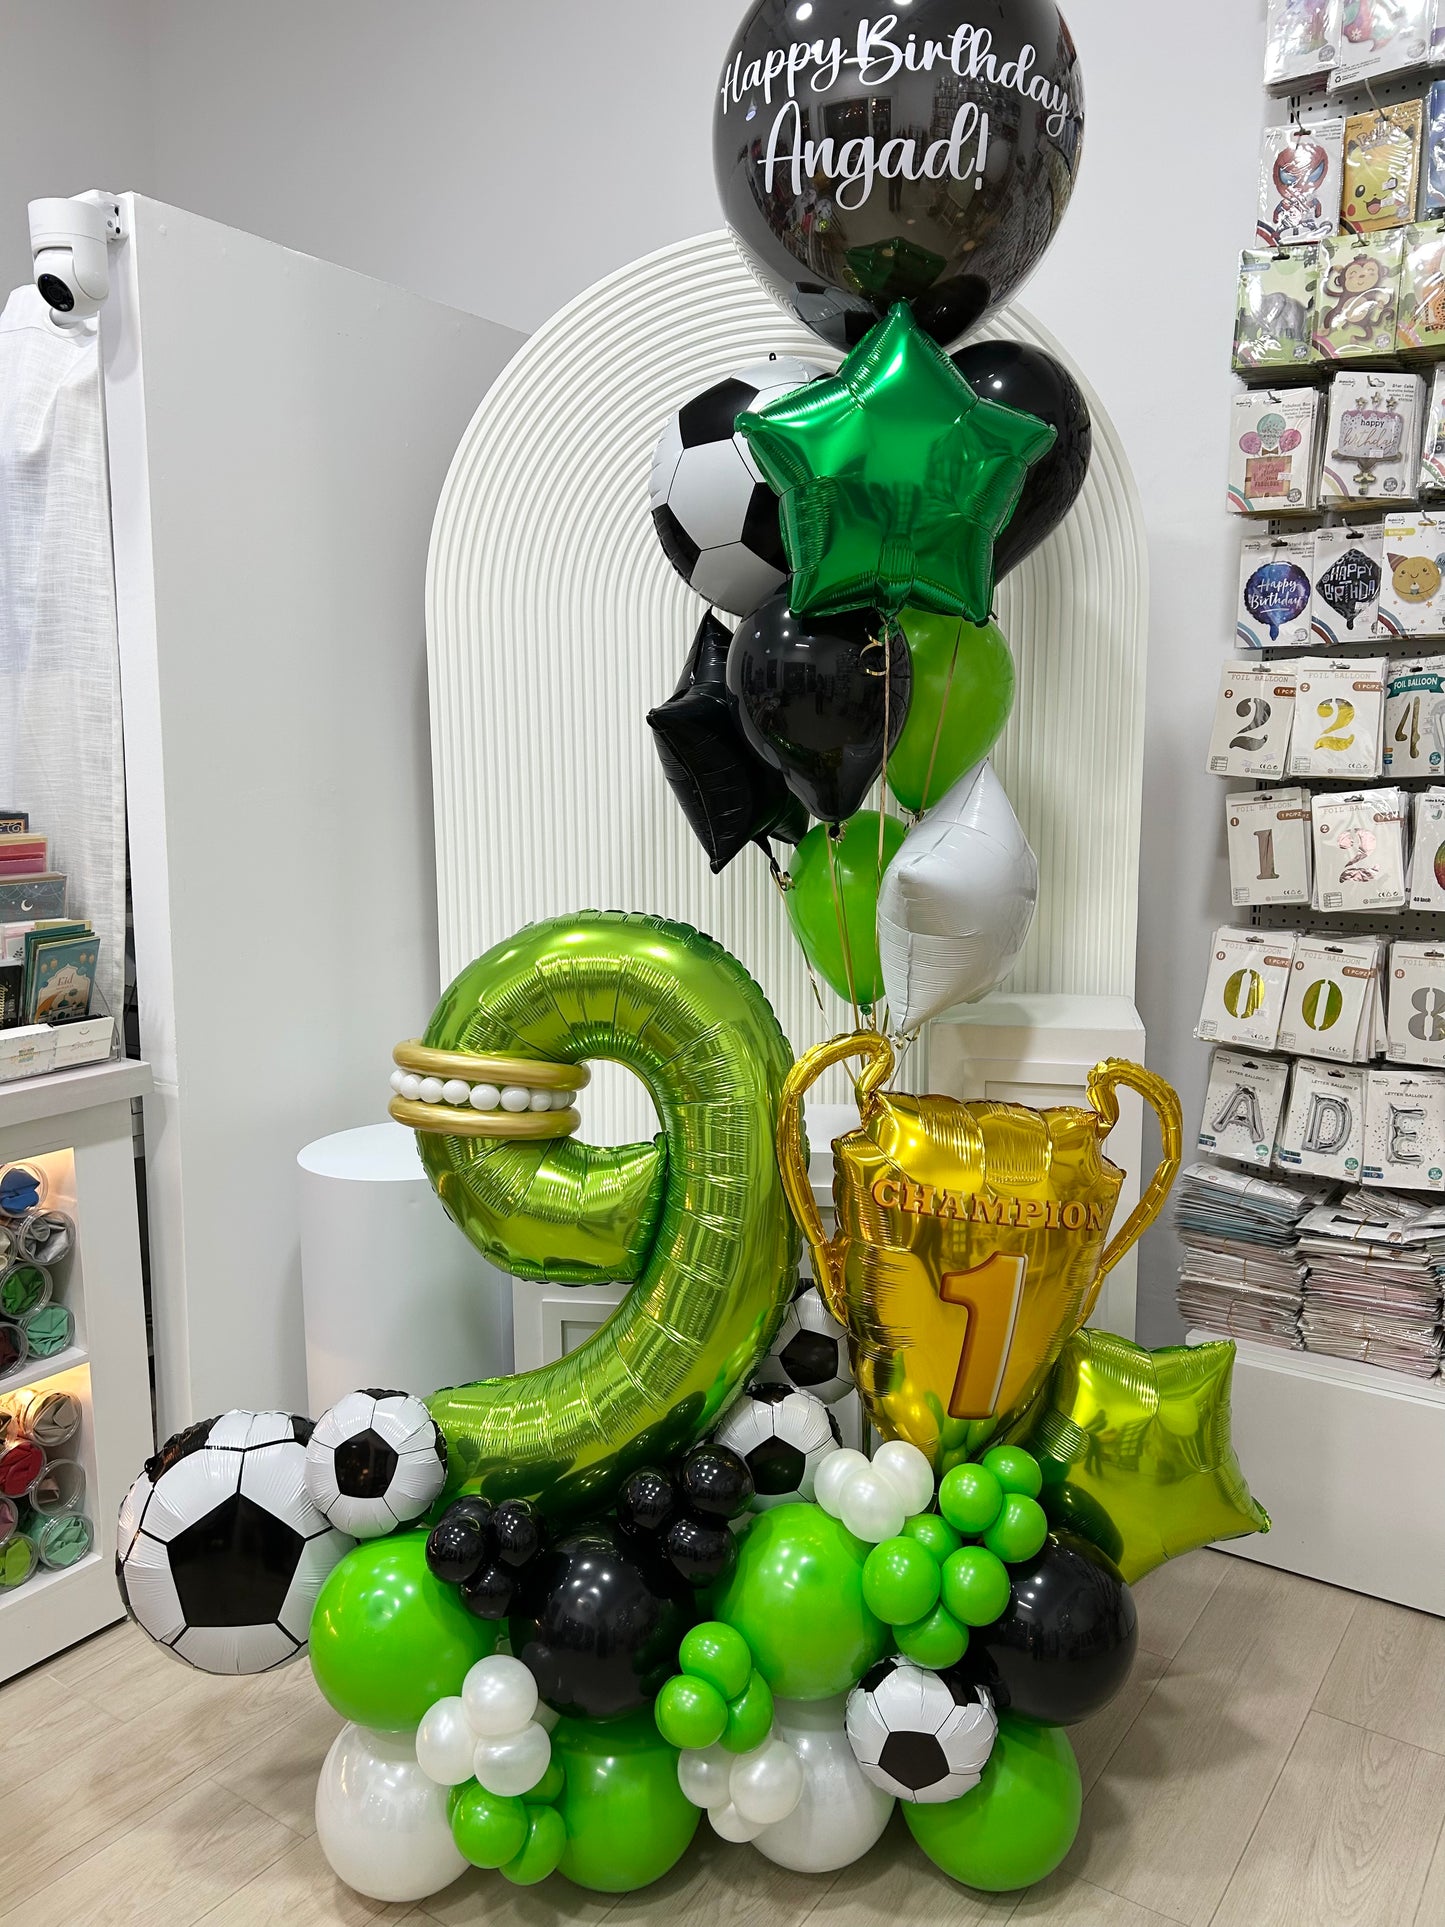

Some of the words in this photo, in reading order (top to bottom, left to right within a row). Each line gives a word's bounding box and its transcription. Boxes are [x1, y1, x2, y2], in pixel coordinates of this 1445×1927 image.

[720, 35, 846, 115] Happy
[843, 14, 1071, 137] Birthday
[757, 100, 989, 210] Angad!
[1343, 428, 1395, 456] birthday
[1361, 420, 1385, 428] happy
[1257, 577, 1299, 593] Happy
[1330, 562, 1373, 581] HAPPY
[1250, 592, 1302, 610] Birthday
[1254, 675, 1289, 683] BALLOON
[1393, 681, 1406, 690] FOIL
[1407, 677, 1438, 687] BALLOON
[1229, 698, 1271, 751] 2
[1314, 698, 1355, 751] 2
[1259, 802, 1292, 811] BALLOON
[1253, 829, 1280, 880] 1
[1337, 828, 1379, 883] 2
[1248, 946, 1282, 954] BALLOON
[1327, 956, 1361, 965] BALLOON
[57, 973, 75, 986] Eid
[1223, 968, 1265, 1020] 0
[1301, 978, 1343, 1031] 0
[1408, 987, 1445, 1041] 8
[1212, 1082, 1266, 1144] A
[1301, 1092, 1353, 1155] D
[1386, 1102, 1427, 1166] E
[871, 1178, 1104, 1232] CHAMPION
[939, 1250, 1029, 1421] 1
